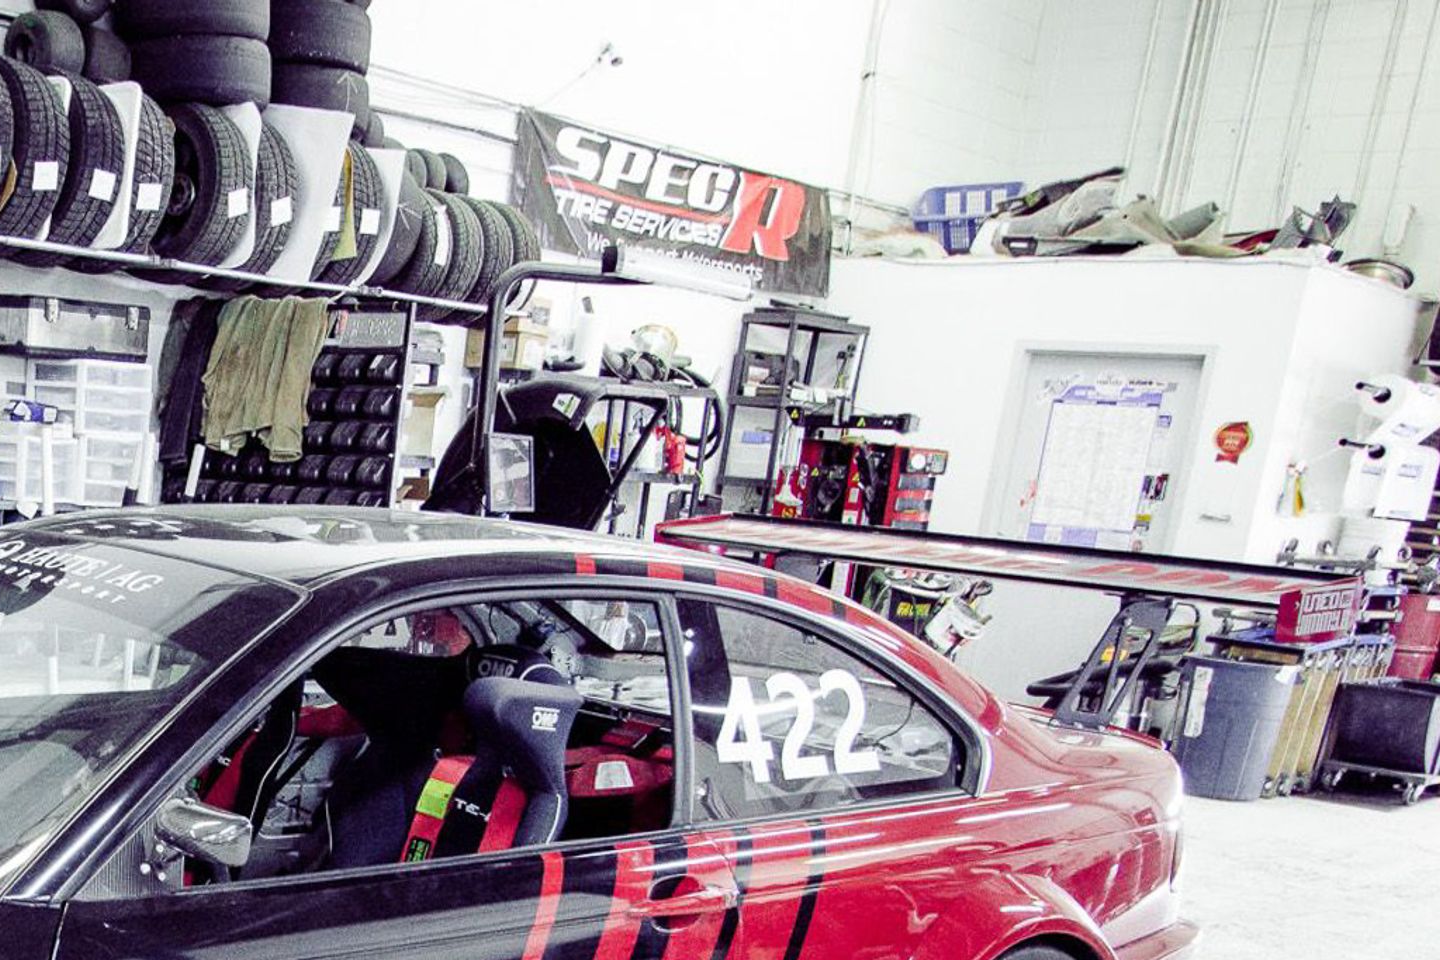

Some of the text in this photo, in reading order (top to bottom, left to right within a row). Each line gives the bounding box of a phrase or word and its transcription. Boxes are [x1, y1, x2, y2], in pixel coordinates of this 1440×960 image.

[548, 126, 806, 261] SPEC R
[556, 188, 723, 246] TIRE SERVICES
[11, 546, 108, 578] HAUTE
[106, 569, 164, 593] AG
[532, 710, 559, 728] OMP
[716, 668, 882, 783] 422
